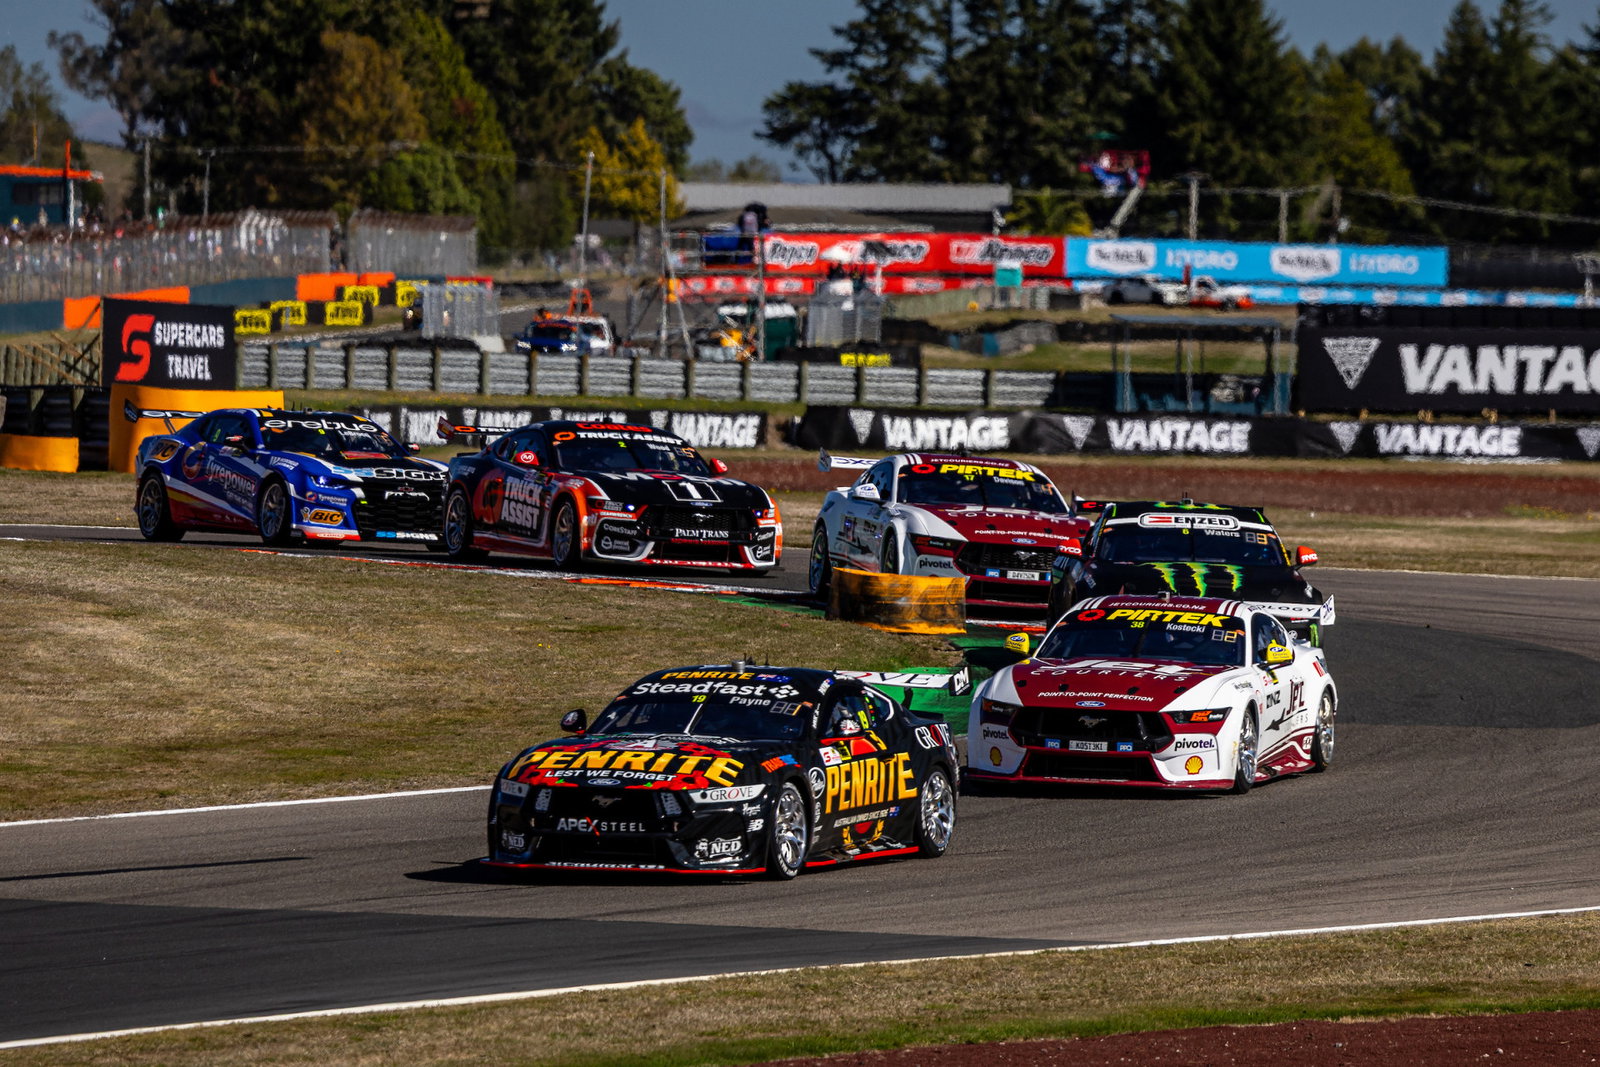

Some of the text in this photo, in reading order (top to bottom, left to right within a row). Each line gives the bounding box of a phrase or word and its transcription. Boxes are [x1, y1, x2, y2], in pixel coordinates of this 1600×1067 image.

[154, 321, 225, 348] SUPERCARS
[166, 354, 213, 381] TRAVEL
[1399, 343, 1600, 395] VANTA
[264, 419, 378, 433] erebus
[576, 423, 652, 433] Coates
[672, 413, 762, 449] VANTAGE
[882, 415, 1009, 450] VANTAGE
[577, 431, 683, 445] TRUCK ASSIST
[1107, 416, 1251, 452] VANTAGE
[1373, 422, 1523, 456] VANTAGE
[206, 455, 256, 497] Tyrepower
[939, 464, 1036, 482] PIRTEK
[505, 475, 543, 507] TRUCK
[501, 499, 540, 530] ASSIST
[1173, 516, 1231, 527] ENZED
[675, 527, 729, 538] PALM TRANS
[1028, 531, 1070, 541] PERFECTION
[1203, 529, 1241, 538] Waters
[1108, 602, 1207, 611] JETCOURIERS.CO.NZ
[1106, 609, 1231, 628] PIRTEK
[1130, 621, 1145, 629] 38
[1166, 622, 1206, 633] Kostecki
[661, 671, 756, 680] PENRITE
[1030, 669, 1188, 682] COURIERS
[632, 681, 768, 697] Steadfast
[691, 695, 707, 703] 19
[729, 696, 772, 707] Payne
[1103, 692, 1153, 702] PERFECTION
[914, 722, 953, 750] GROVE
[508, 750, 745, 787] PENRITE
[545, 769, 677, 782] LEST WE FORGET
[824, 751, 919, 815] PENRITE
[709, 786, 754, 801] GROVE
[557, 816, 645, 836] APEX STEEL
[711, 840, 742, 855] NED
